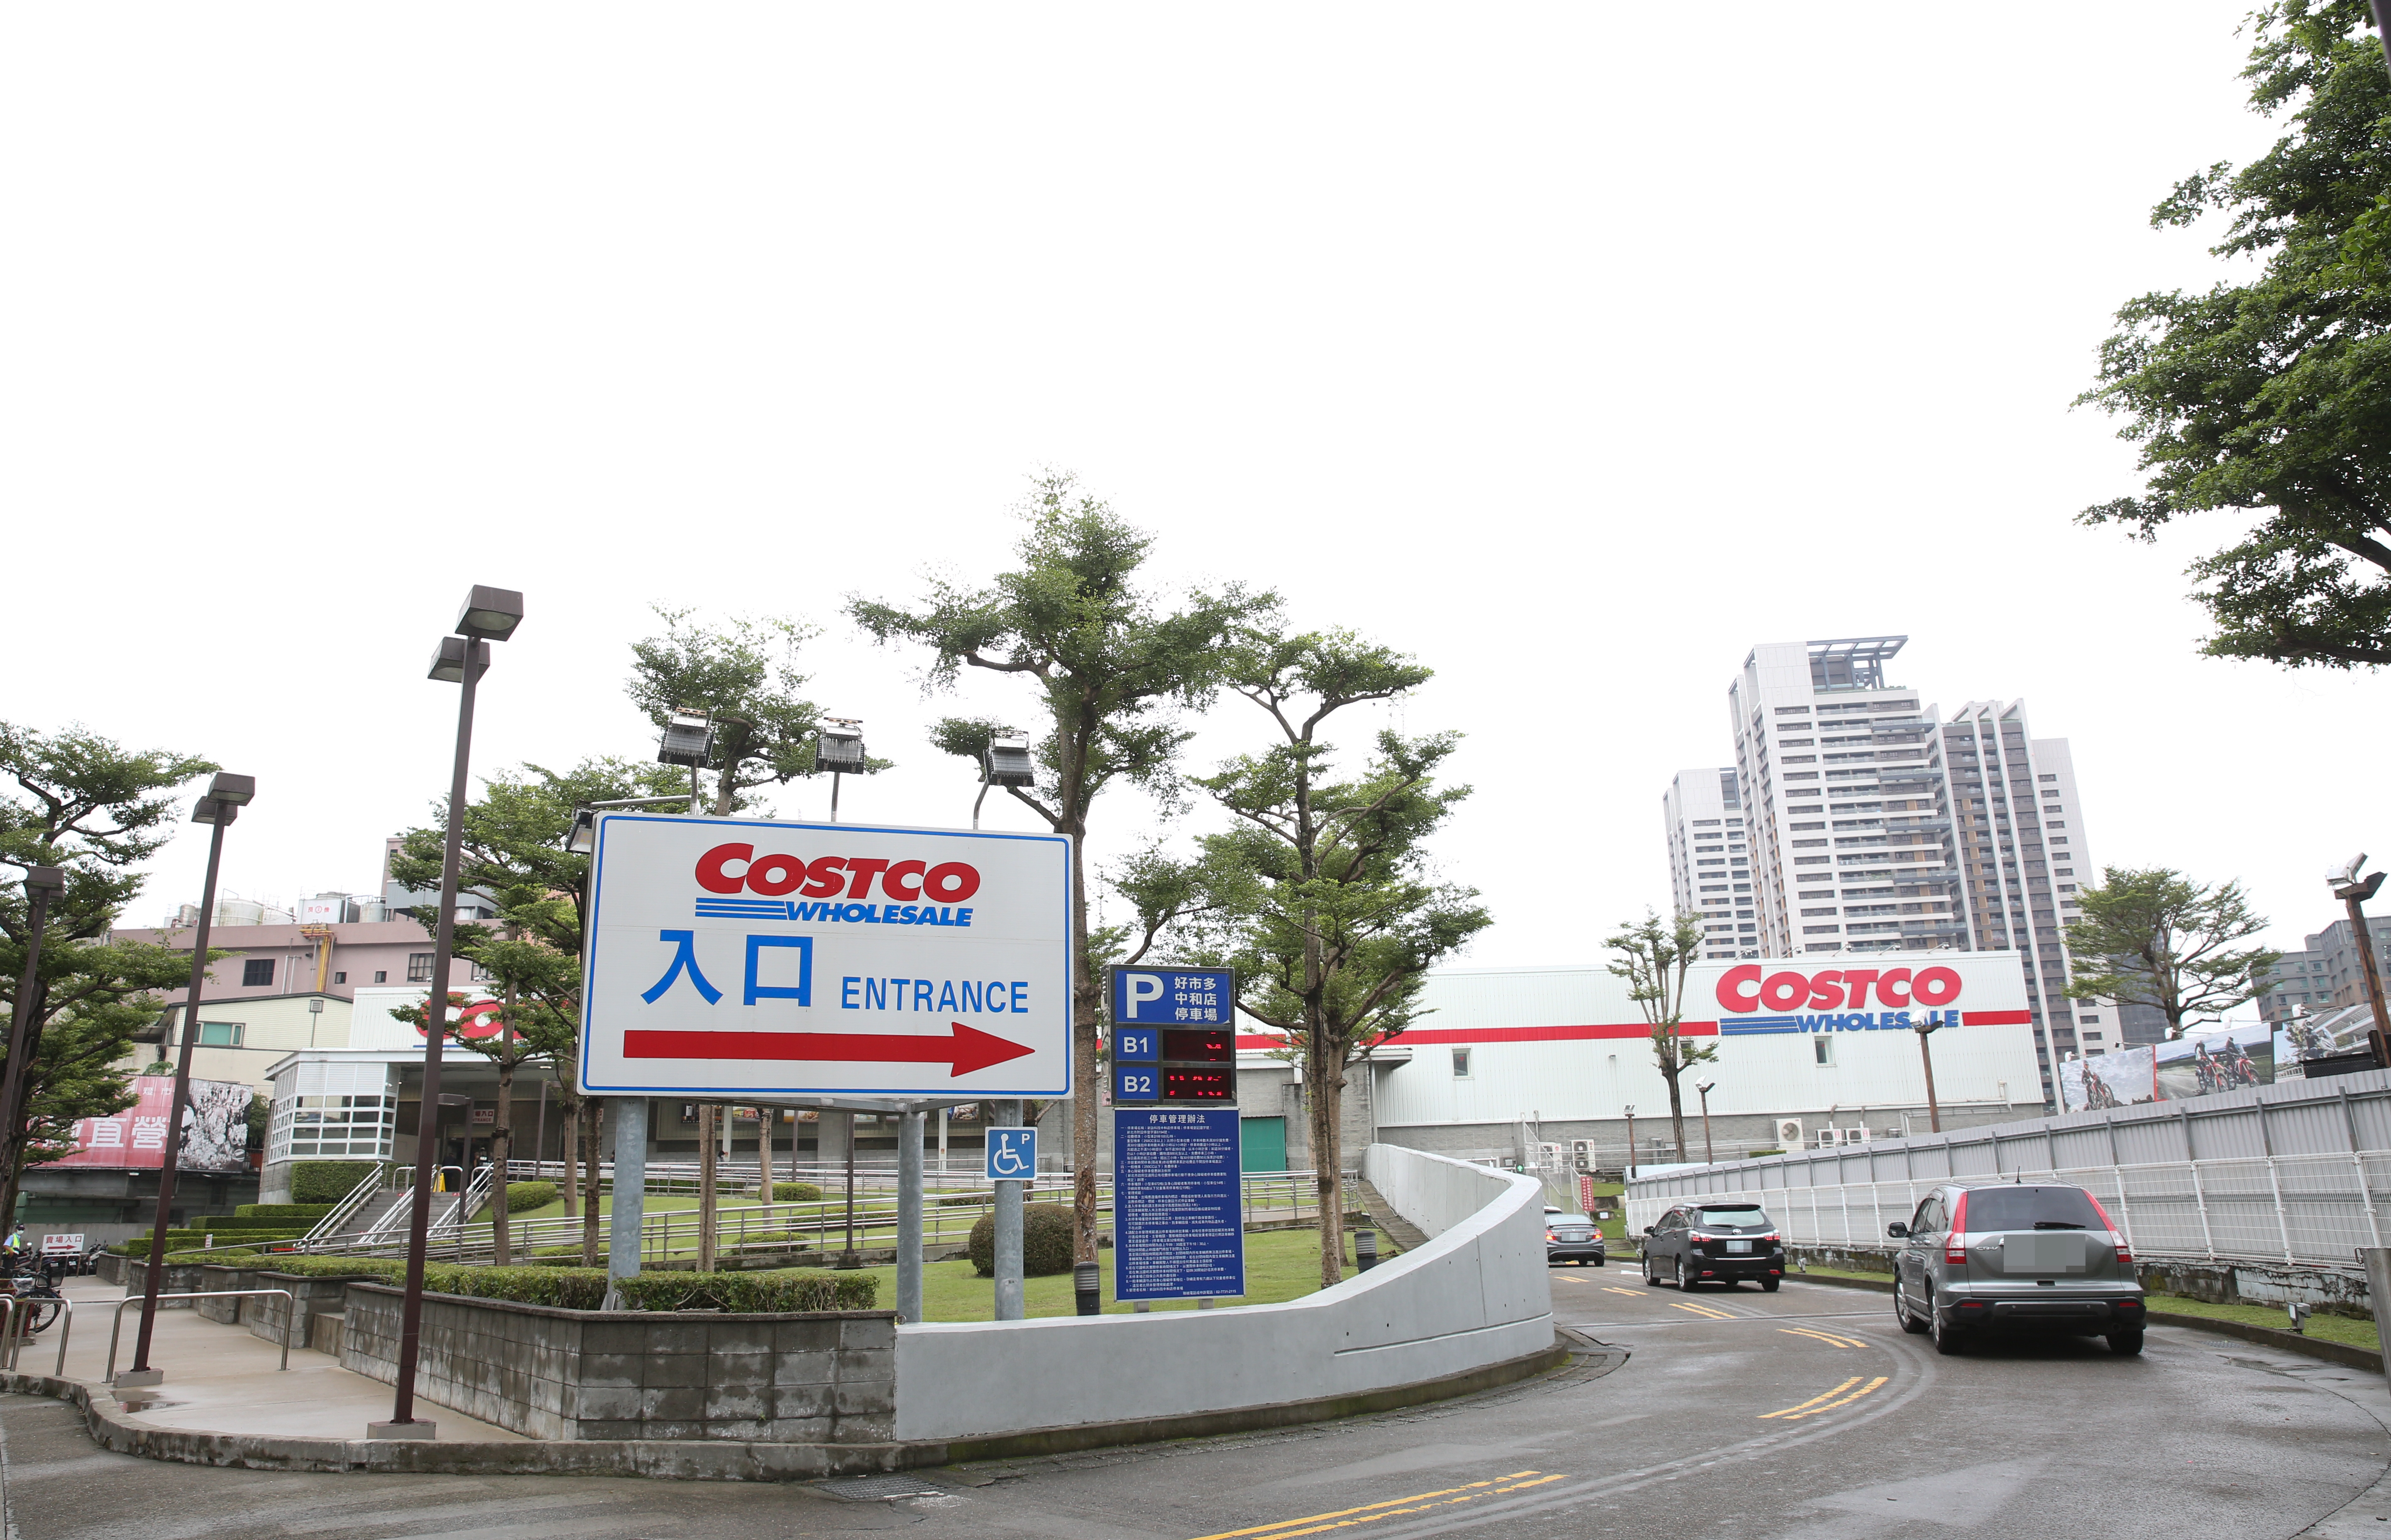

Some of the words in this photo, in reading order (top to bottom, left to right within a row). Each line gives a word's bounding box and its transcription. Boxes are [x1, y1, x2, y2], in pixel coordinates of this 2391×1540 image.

[695, 843, 980, 903] COSTCO
[786, 901, 973, 927] WHOLESALE
[641, 930, 813, 1007] 入口
[842, 976, 1029, 1013] ENTRANCE
[1174, 976, 1217, 990] 好市多
[1716, 964, 1962, 1013] COSTCO
[1126, 974, 1164, 1018] P
[1175, 992, 1217, 1006] 中和店
[1175, 1007, 1218, 1021] 停車場
[1795, 1010, 1959, 1032] WHOLESLE
[1123, 1037, 1148, 1053] B1
[1124, 1076, 1151, 1092] B2
[1149, 1114, 1205, 1124] 停車管理辦法
[1021, 1133, 1030, 1145] P
